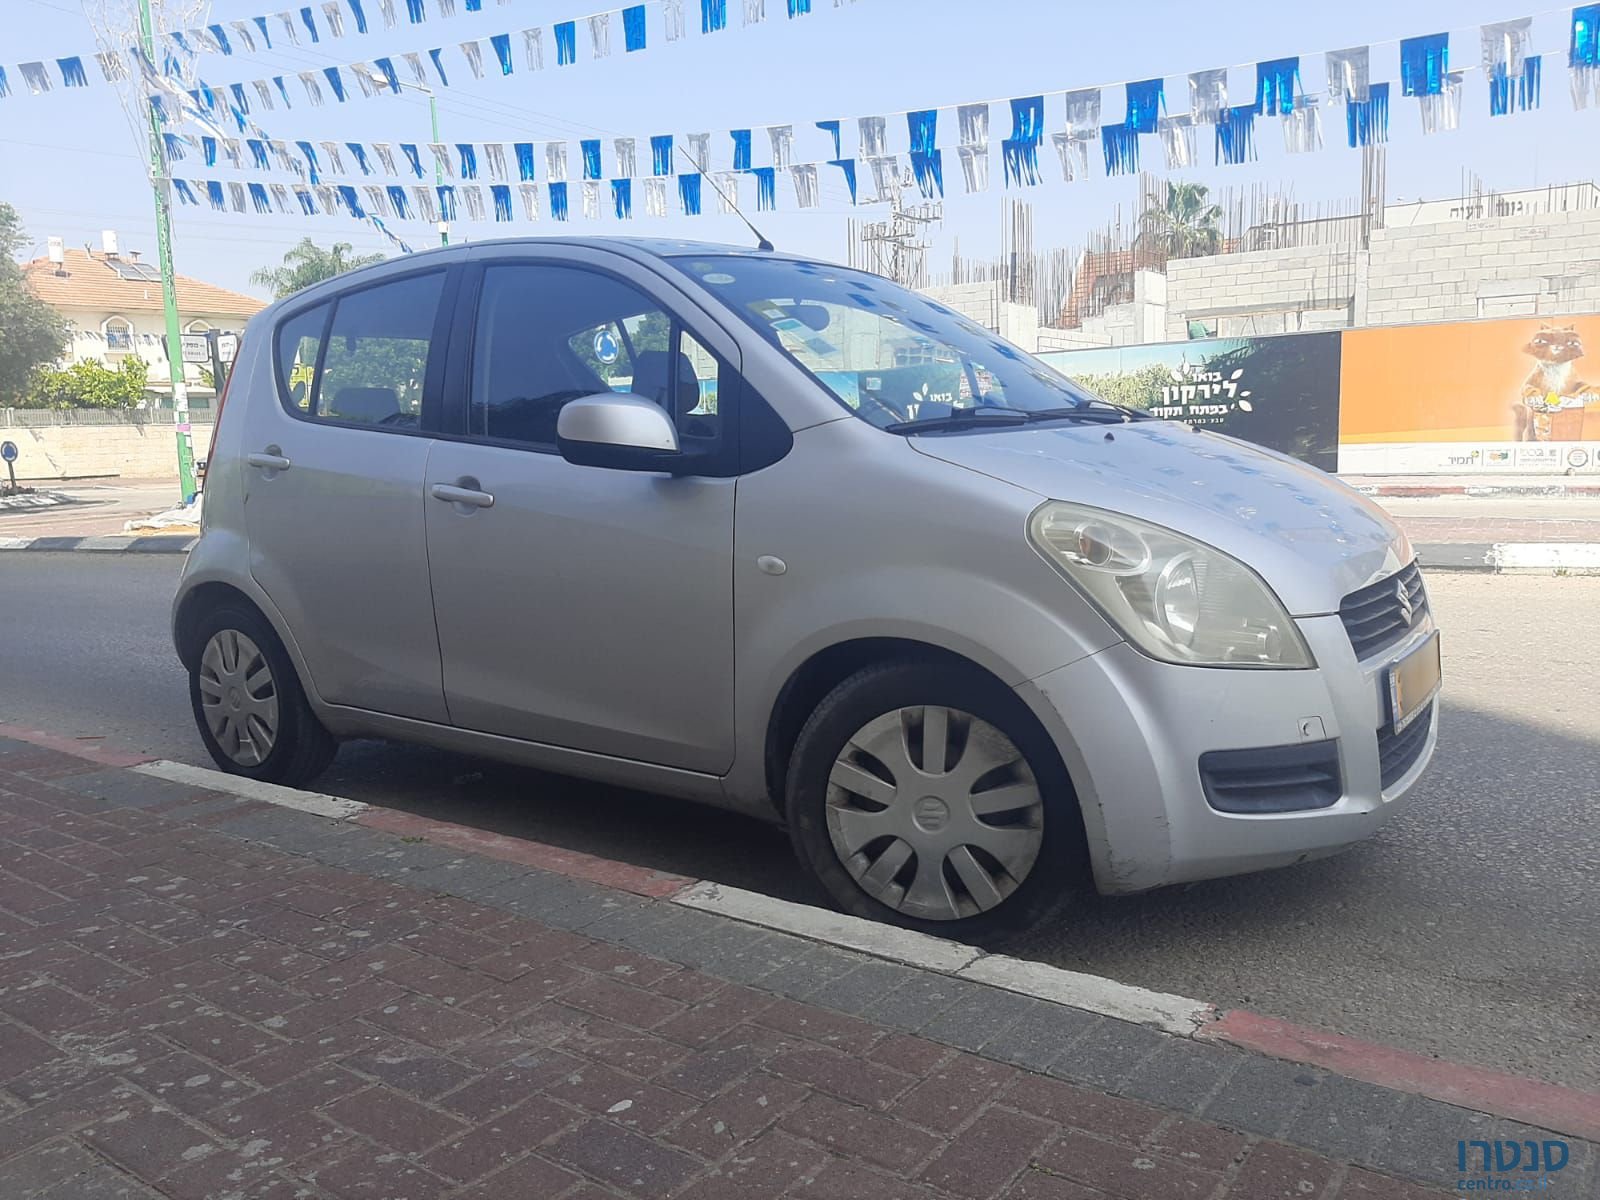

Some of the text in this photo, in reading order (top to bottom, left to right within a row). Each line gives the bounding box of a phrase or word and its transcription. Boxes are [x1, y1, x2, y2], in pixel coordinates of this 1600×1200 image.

[1193, 372, 1222, 381] בואו
[1162, 381, 1237, 405] לירקון
[1190, 405, 1228, 414] בפתח
[1448, 456, 1474, 465] תמיר
